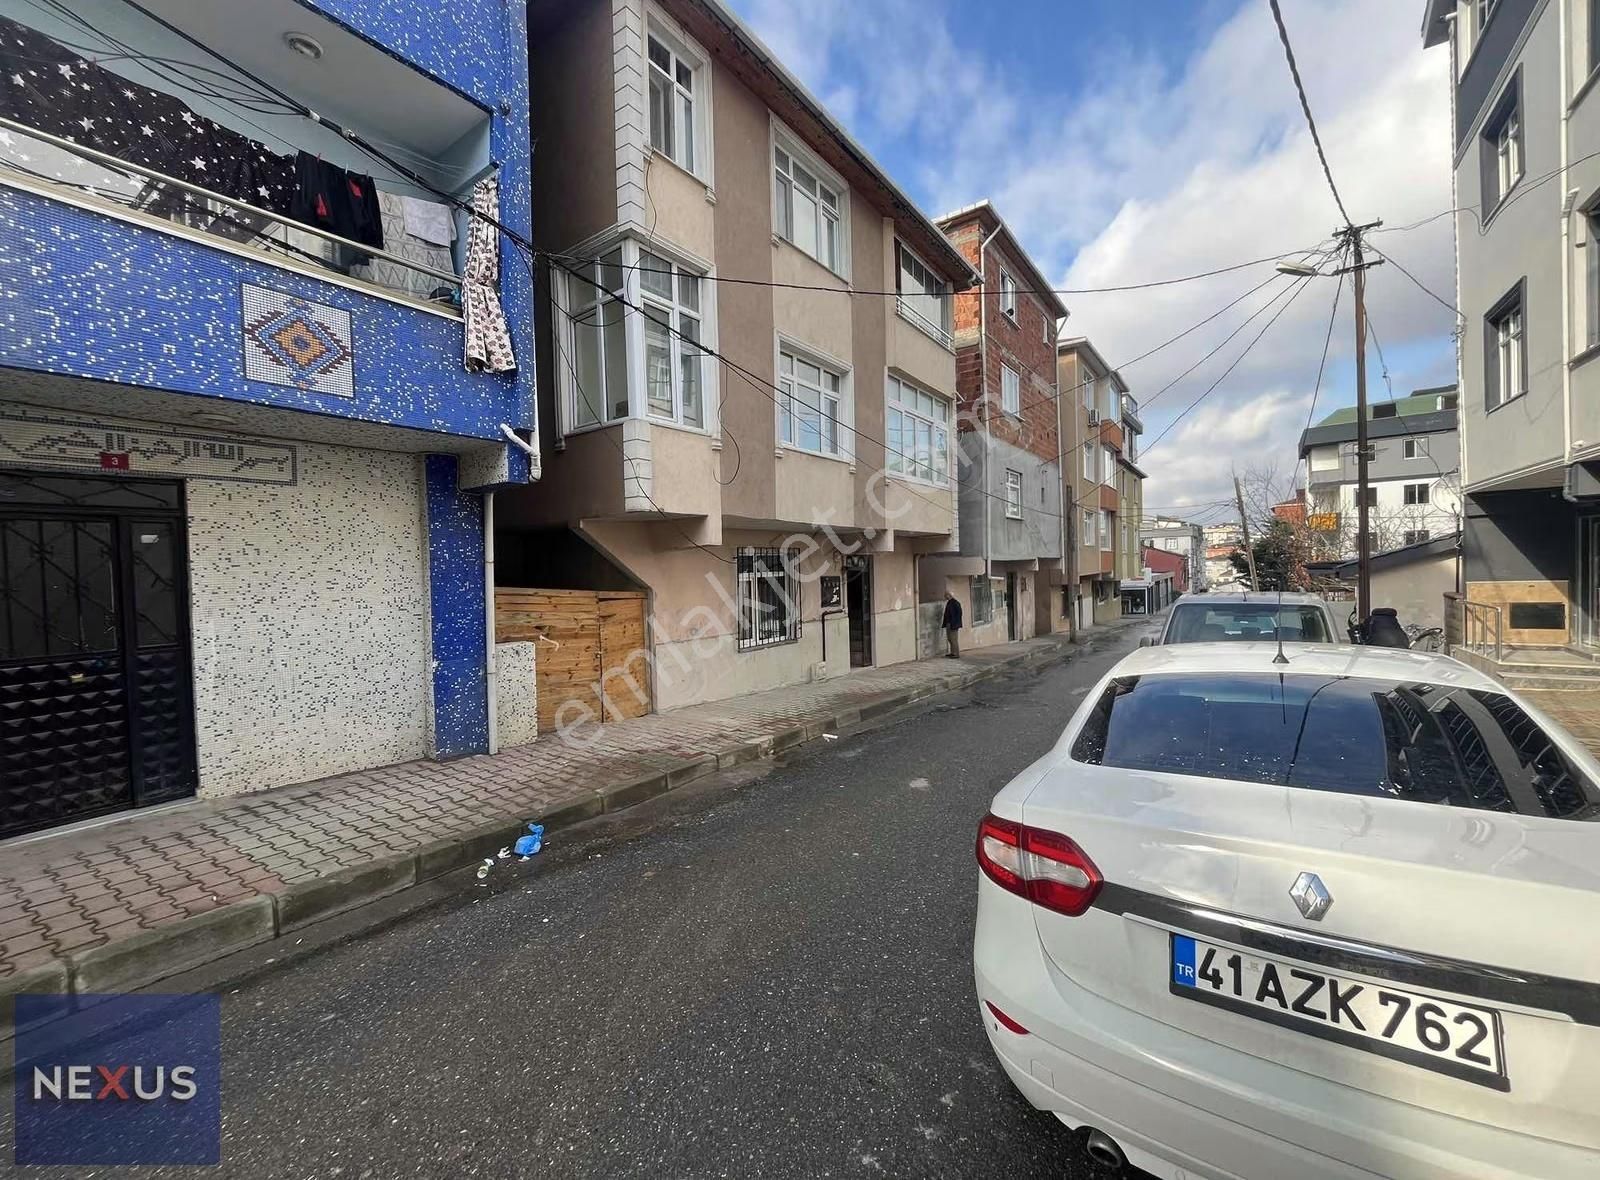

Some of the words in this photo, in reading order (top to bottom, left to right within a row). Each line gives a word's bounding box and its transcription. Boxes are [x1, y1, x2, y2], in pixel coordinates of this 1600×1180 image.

[111, 456, 118, 465] 3
[1176, 962, 1194, 978] TR
[1198, 947, 1242, 996] 41
[1255, 962, 1366, 1031] AZK
[1378, 991, 1491, 1066] 762
